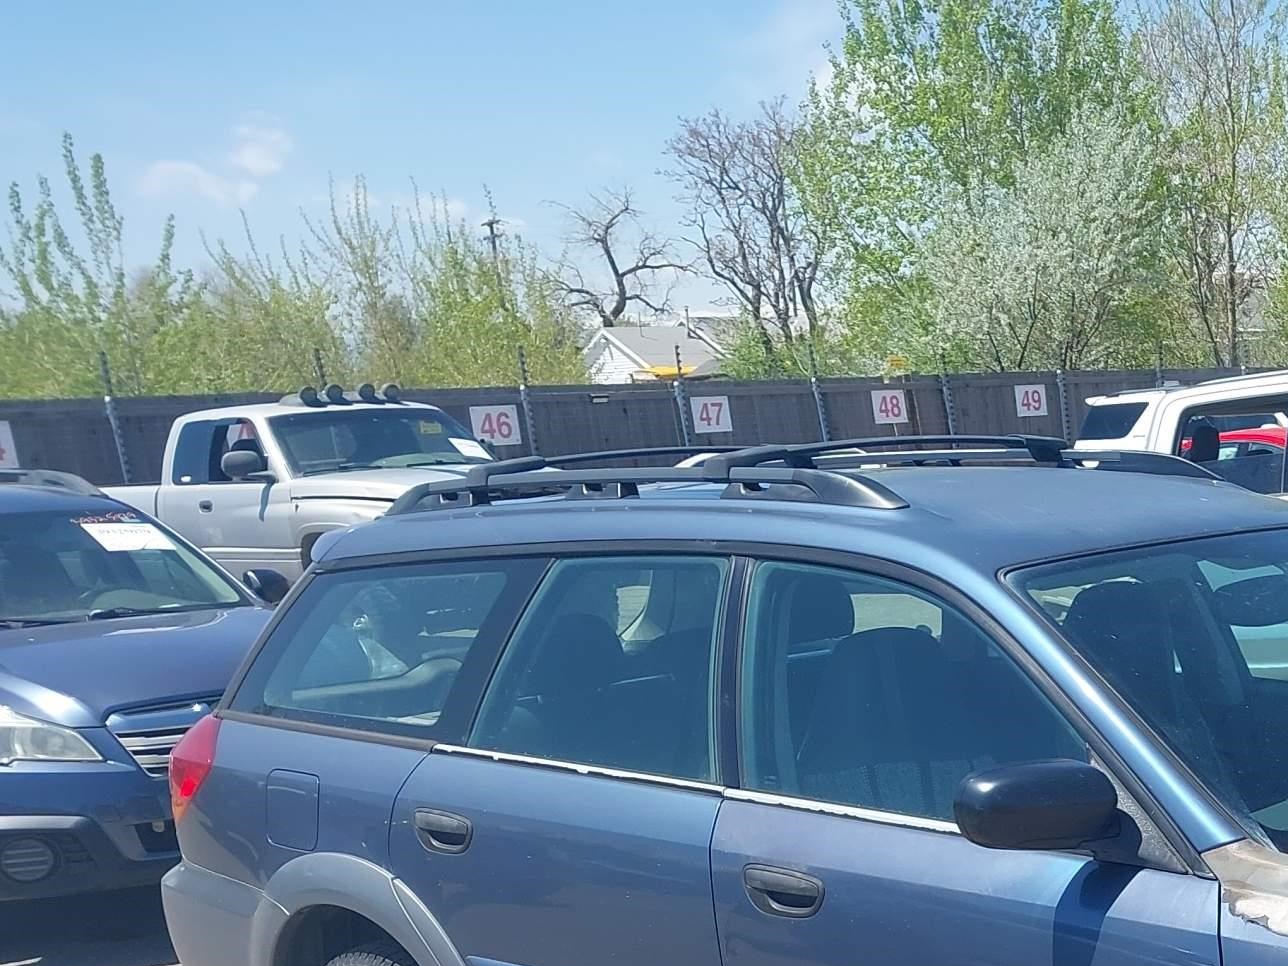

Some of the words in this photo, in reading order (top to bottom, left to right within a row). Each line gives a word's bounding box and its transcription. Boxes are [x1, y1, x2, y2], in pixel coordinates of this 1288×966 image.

[879, 395, 902, 418] 48
[1021, 390, 1042, 411] 49
[481, 411, 513, 440] 46
[700, 402, 723, 426] 47
